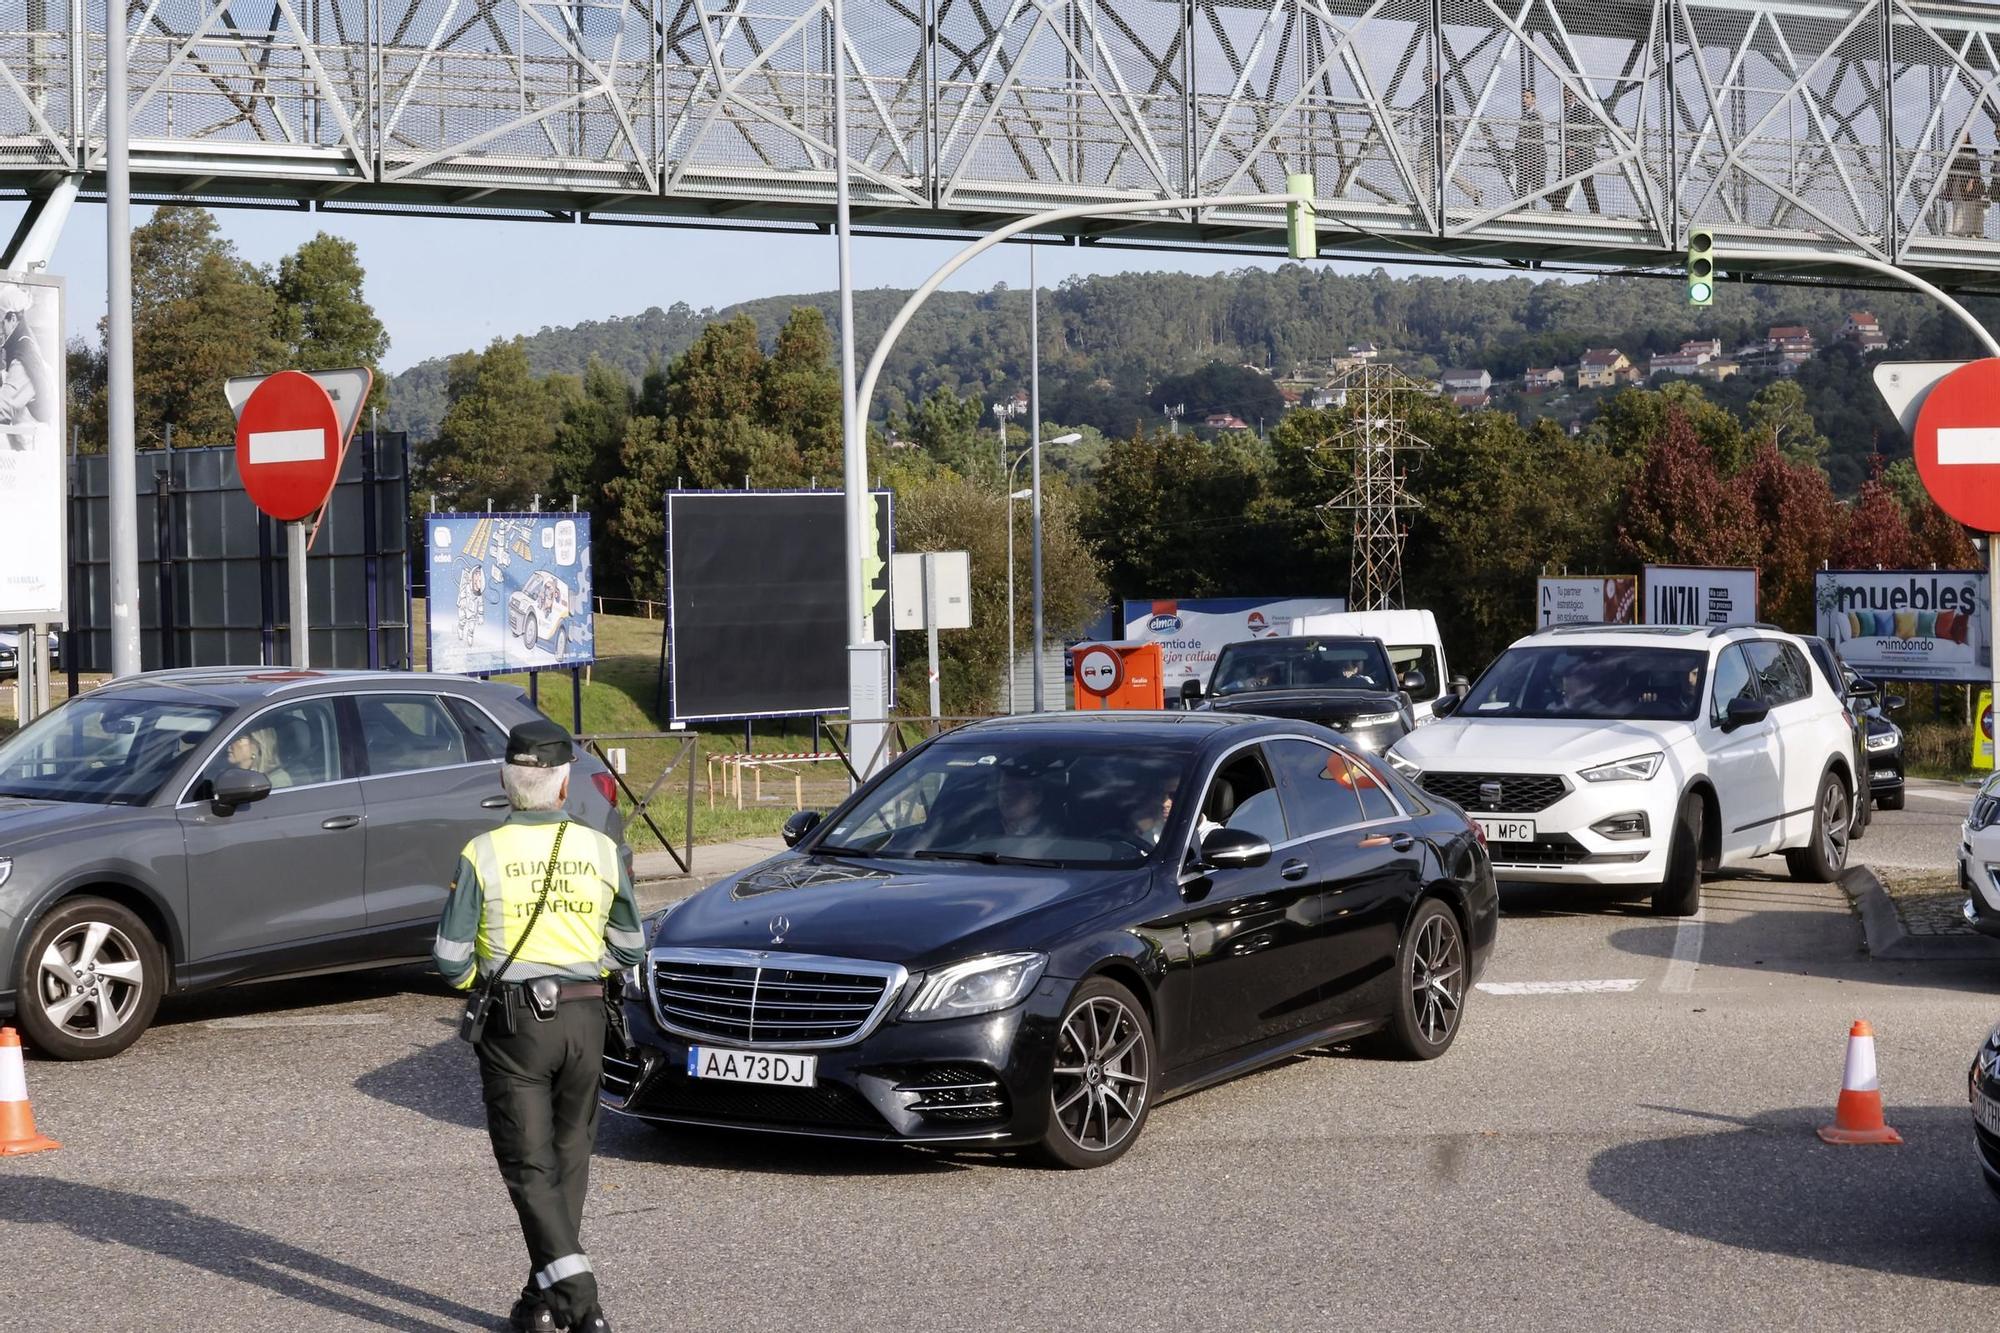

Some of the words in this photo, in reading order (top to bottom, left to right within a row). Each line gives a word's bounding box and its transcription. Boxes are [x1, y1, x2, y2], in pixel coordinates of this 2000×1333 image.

[1838, 578, 1976, 615] muebles
[1151, 617, 1178, 630] elmar
[1187, 638, 1202, 649] de
[1876, 637, 1934, 651] mimoondo
[1163, 651, 1183, 664] ejor
[1185, 650, 1217, 662] calida
[1499, 824, 1528, 839] MPC
[505, 861, 597, 878] GUARDIA
[531, 879, 574, 894] CVIL
